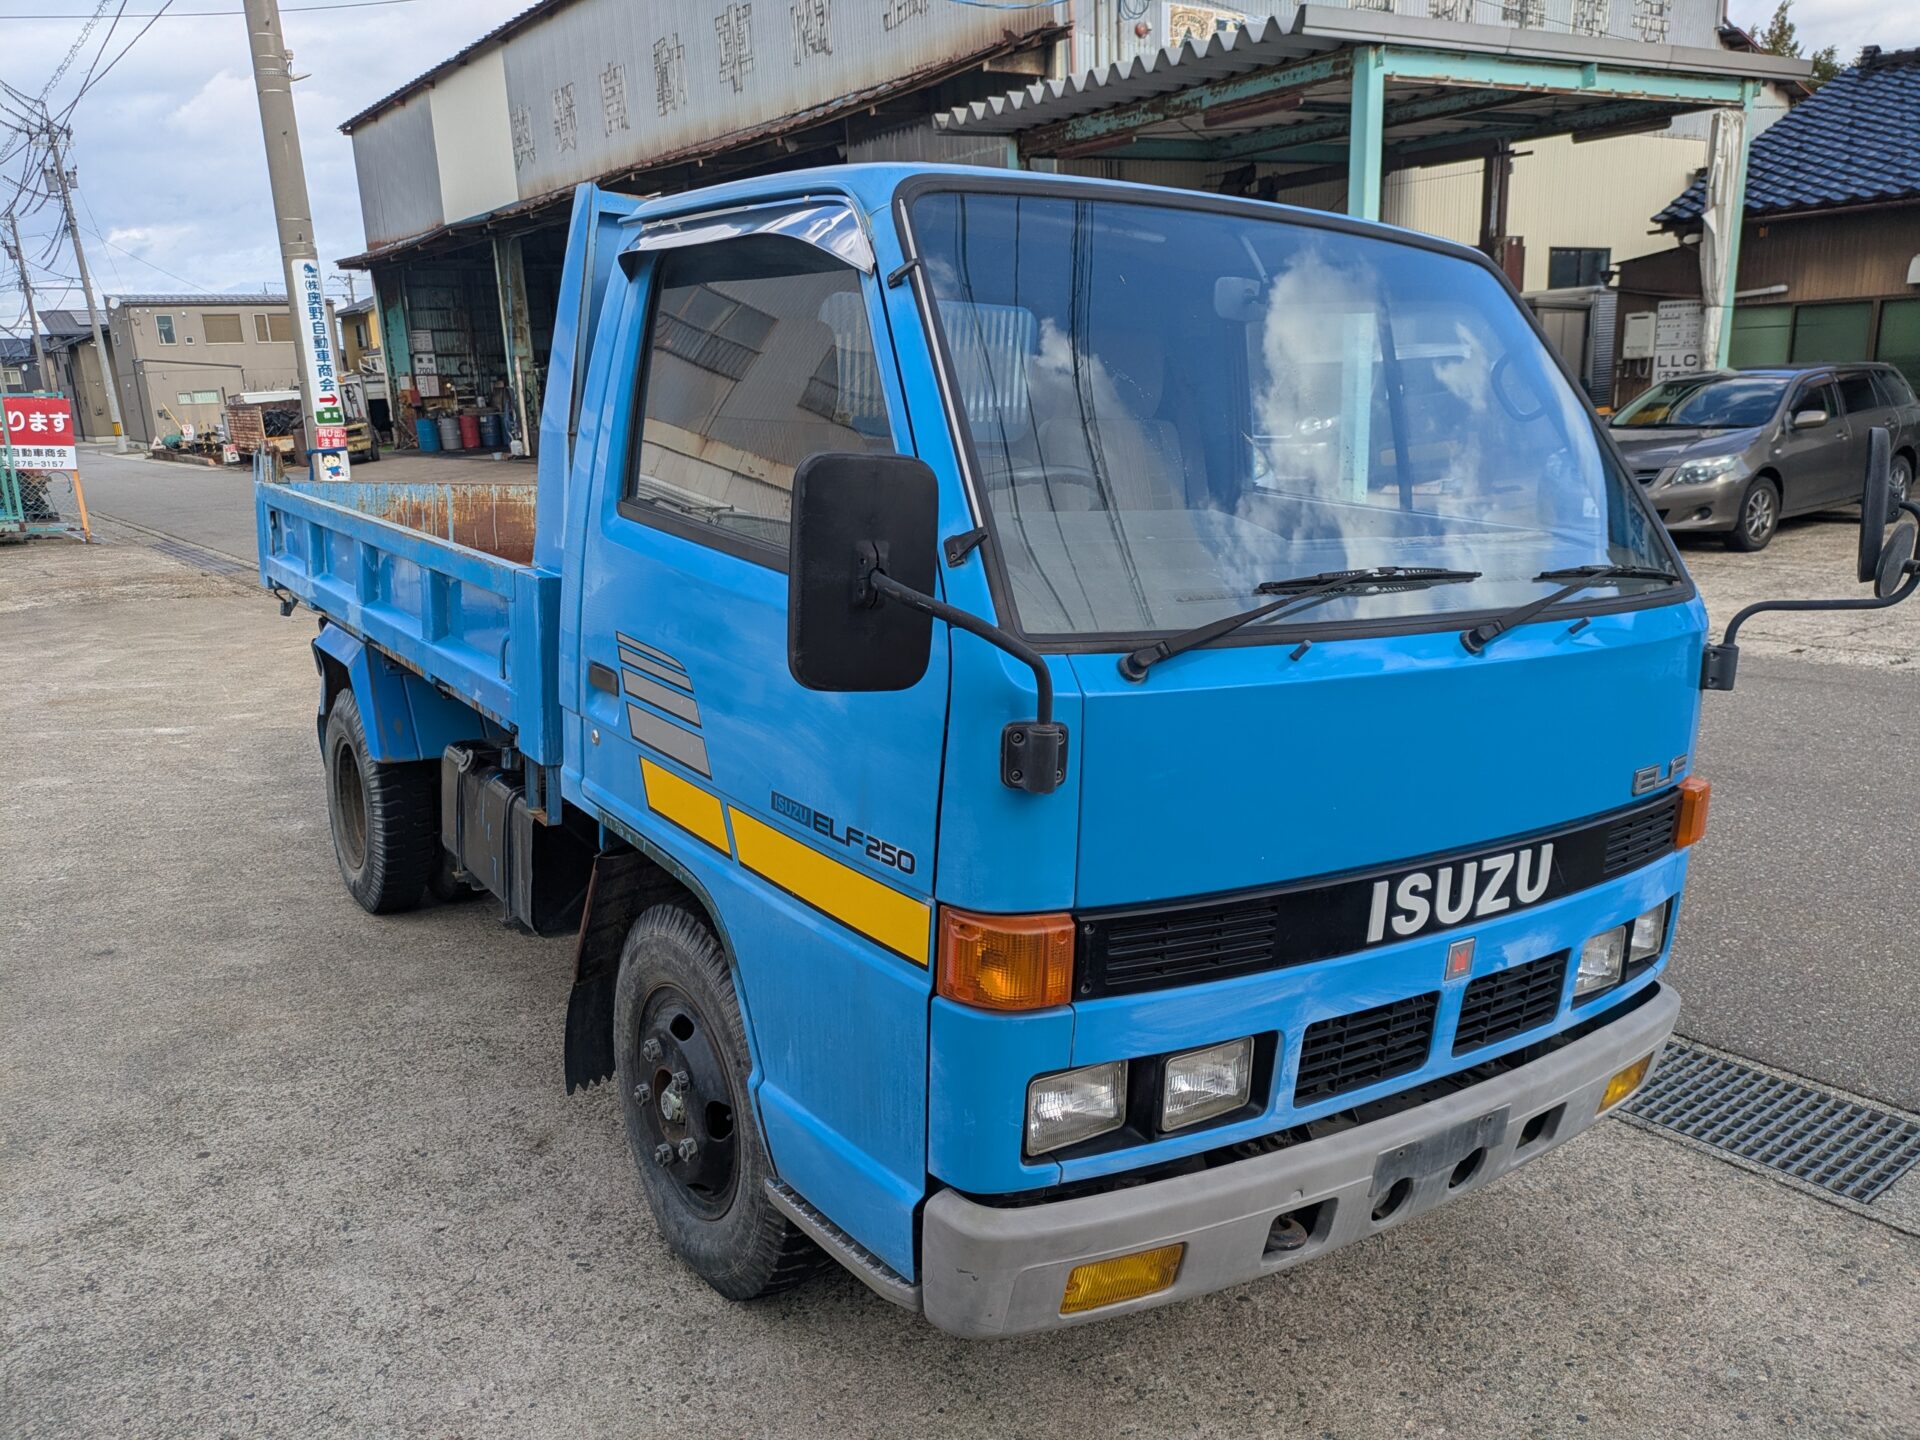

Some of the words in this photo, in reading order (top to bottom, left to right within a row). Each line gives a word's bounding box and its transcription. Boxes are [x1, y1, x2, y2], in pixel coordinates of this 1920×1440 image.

[1657, 354, 1697, 368] LLC
[0, 411, 69, 432] ります
[1632, 754, 1688, 796] ELF
[774, 794, 809, 824] ISUZU
[813, 810, 864, 847] ELF
[865, 835, 916, 875] 250
[1366, 843, 1554, 944] ISUZU
